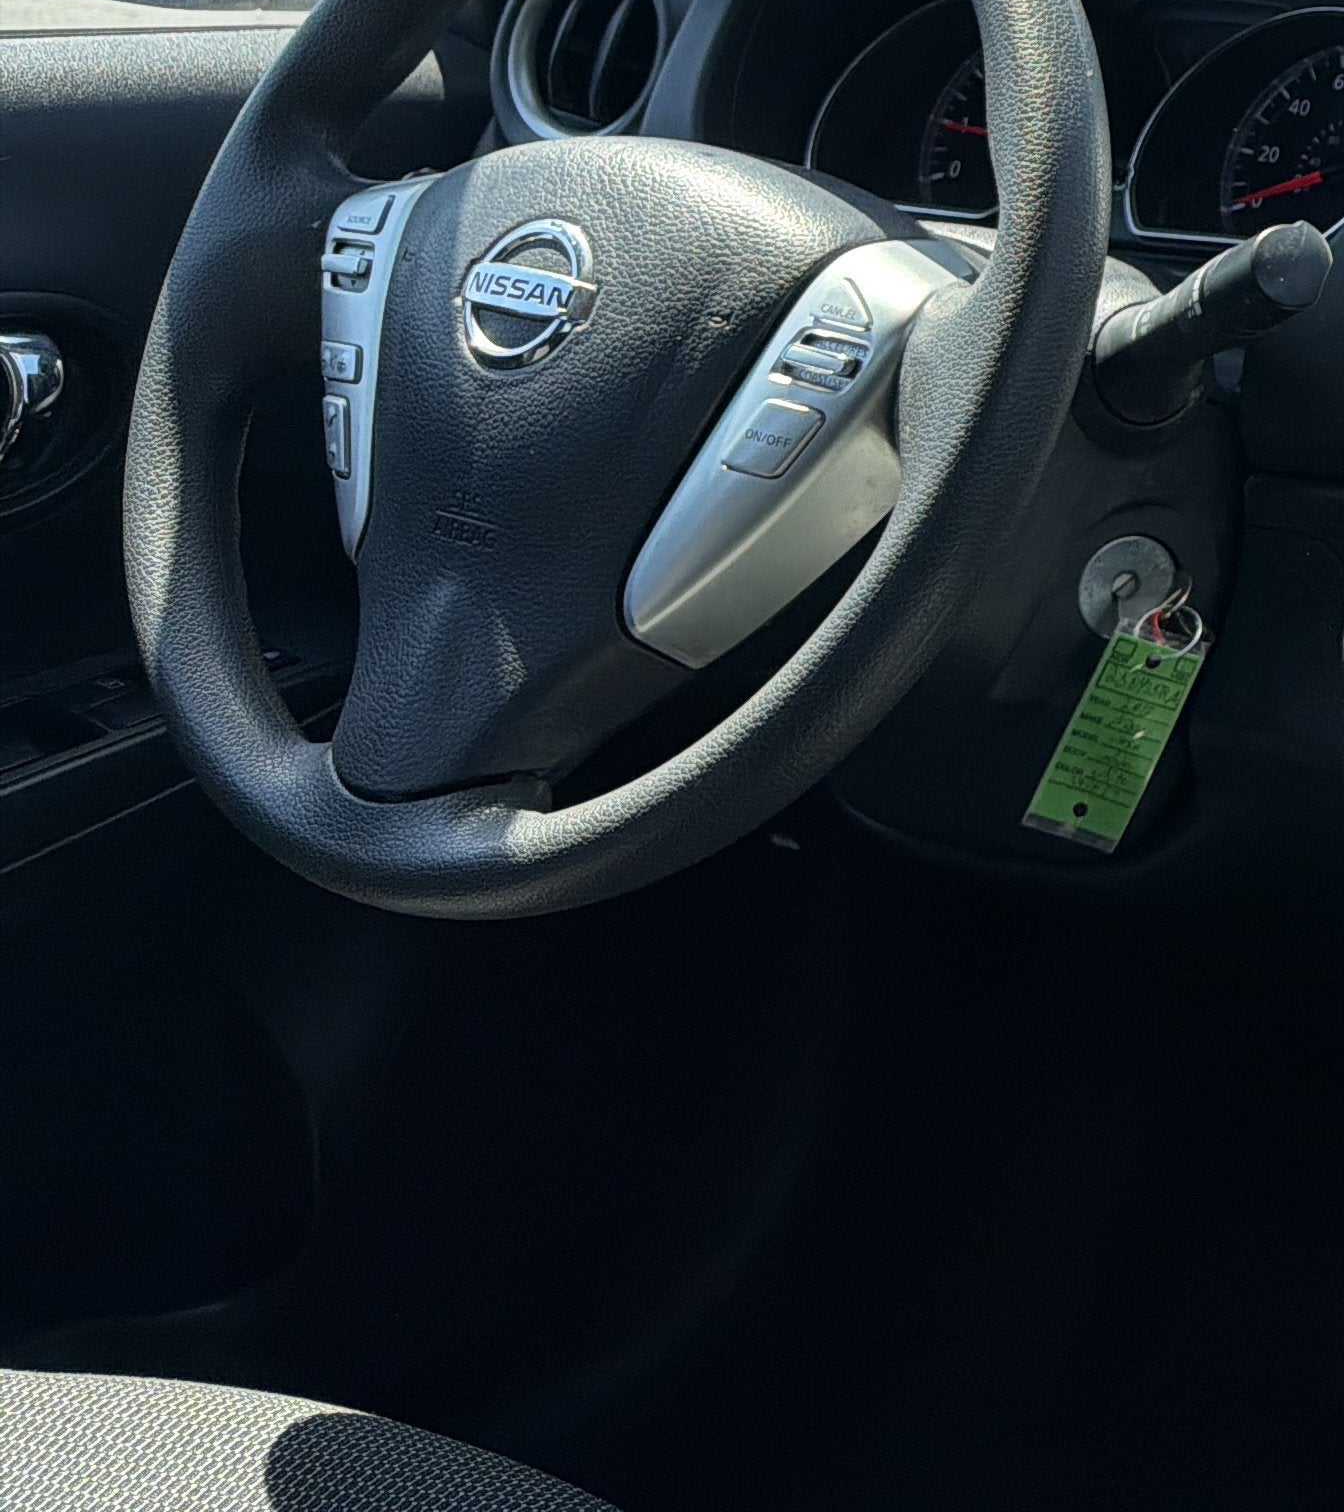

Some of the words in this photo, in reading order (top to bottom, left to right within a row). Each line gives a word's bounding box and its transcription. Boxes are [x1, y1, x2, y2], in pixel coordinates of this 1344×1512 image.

[1288, 99, 1311, 116] 40
[1257, 144, 1280, 163] 20
[949, 159, 961, 178] 0
[469, 271, 574, 309] NISSAN
[820, 302, 858, 321] CANCEL
[744, 428, 793, 449] ON/OFF
